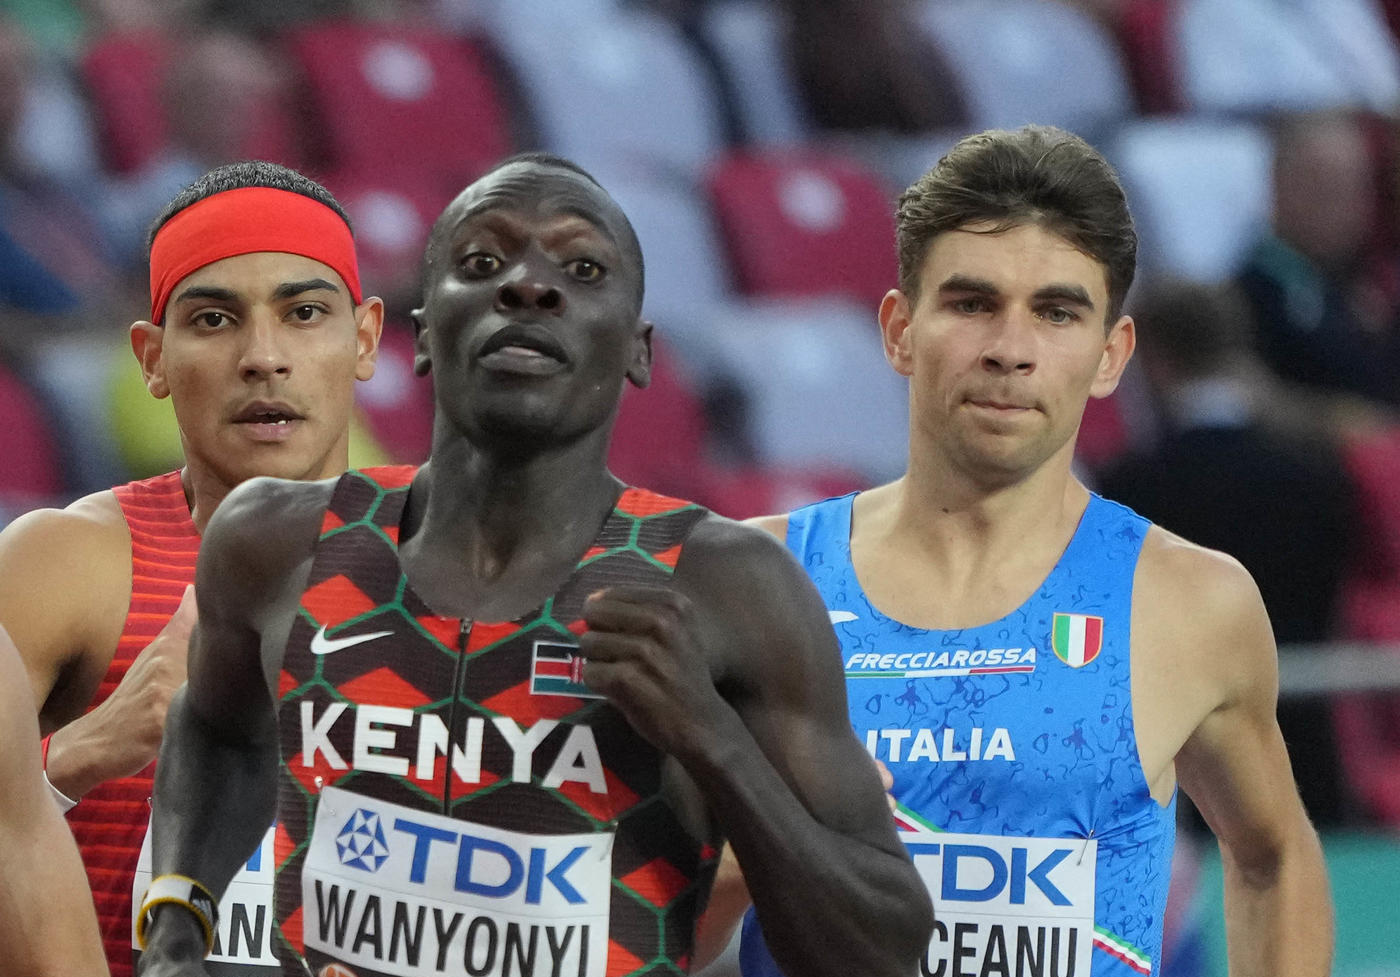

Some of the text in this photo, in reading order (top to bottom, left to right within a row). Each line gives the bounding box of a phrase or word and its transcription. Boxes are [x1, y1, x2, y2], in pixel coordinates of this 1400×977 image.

[845, 648, 1036, 669] FRECCIAROSSA
[301, 700, 608, 794] KENYA
[866, 728, 1016, 762] ITALIA
[394, 818, 593, 905] TDK
